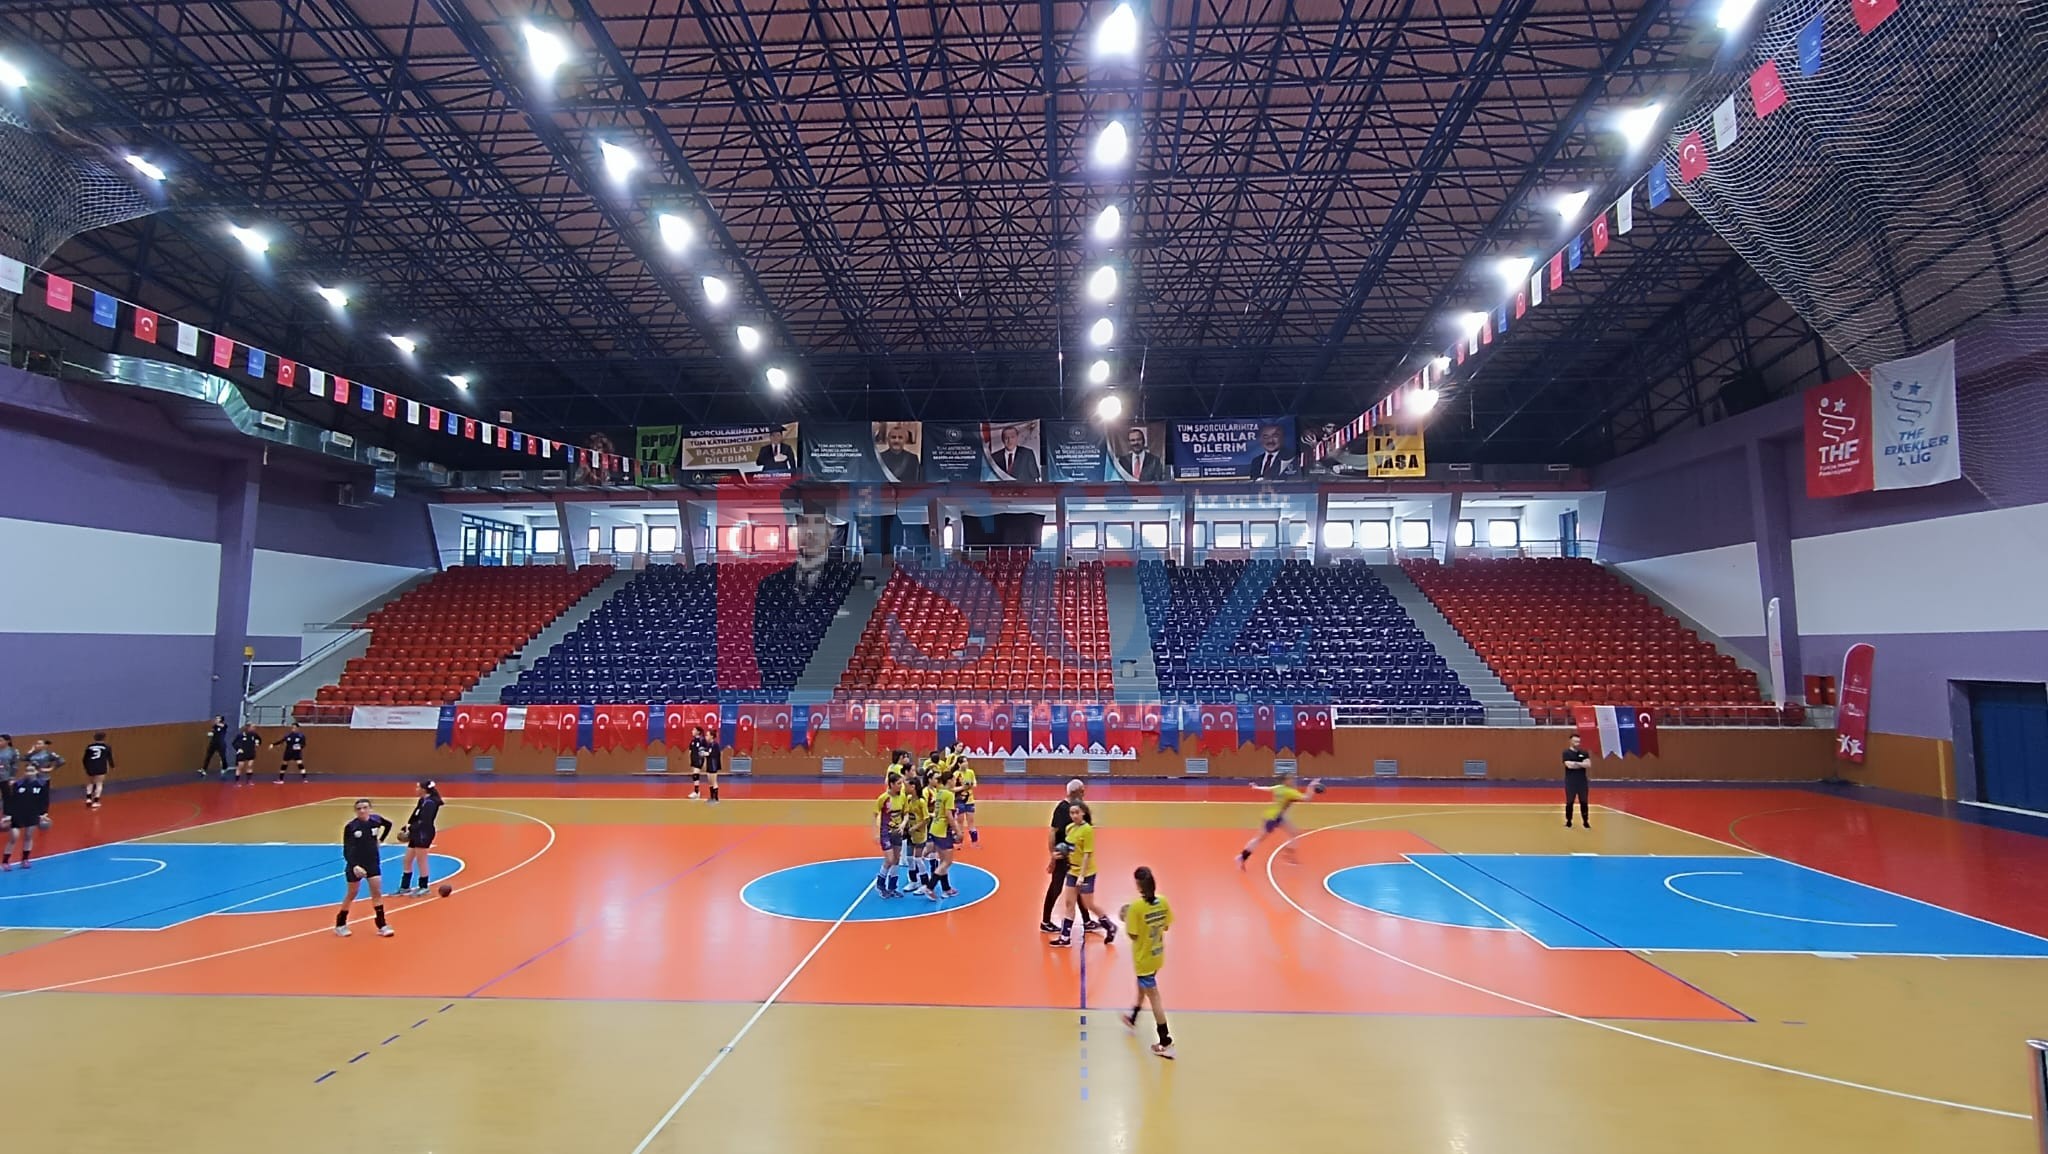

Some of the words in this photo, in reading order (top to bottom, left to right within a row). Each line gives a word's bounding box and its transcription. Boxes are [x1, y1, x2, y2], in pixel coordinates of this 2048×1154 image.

[1899, 427, 1926, 441] THF
[696, 445, 753, 457] BAŞARILAR
[1818, 438, 1860, 464] THF
[1884, 434, 1950, 456] ERKEKLER
[90, 747, 102, 759] 3
